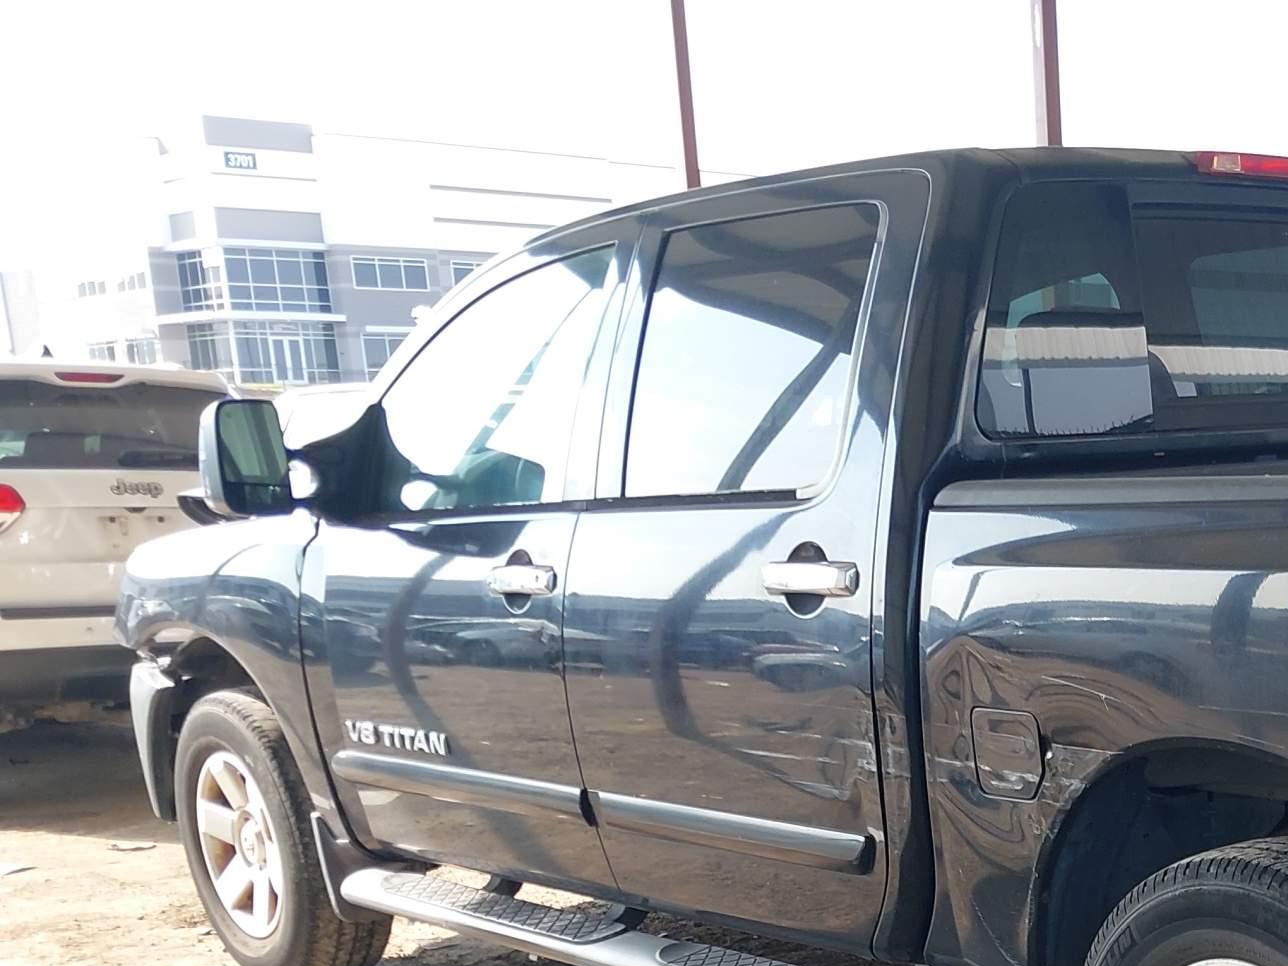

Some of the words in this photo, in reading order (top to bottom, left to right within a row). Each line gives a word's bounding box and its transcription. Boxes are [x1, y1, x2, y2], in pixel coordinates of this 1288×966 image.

[227, 153, 254, 168] 3701
[110, 479, 163, 498] Jeep
[344, 720, 376, 745] V8
[378, 725, 447, 756] TITAN
